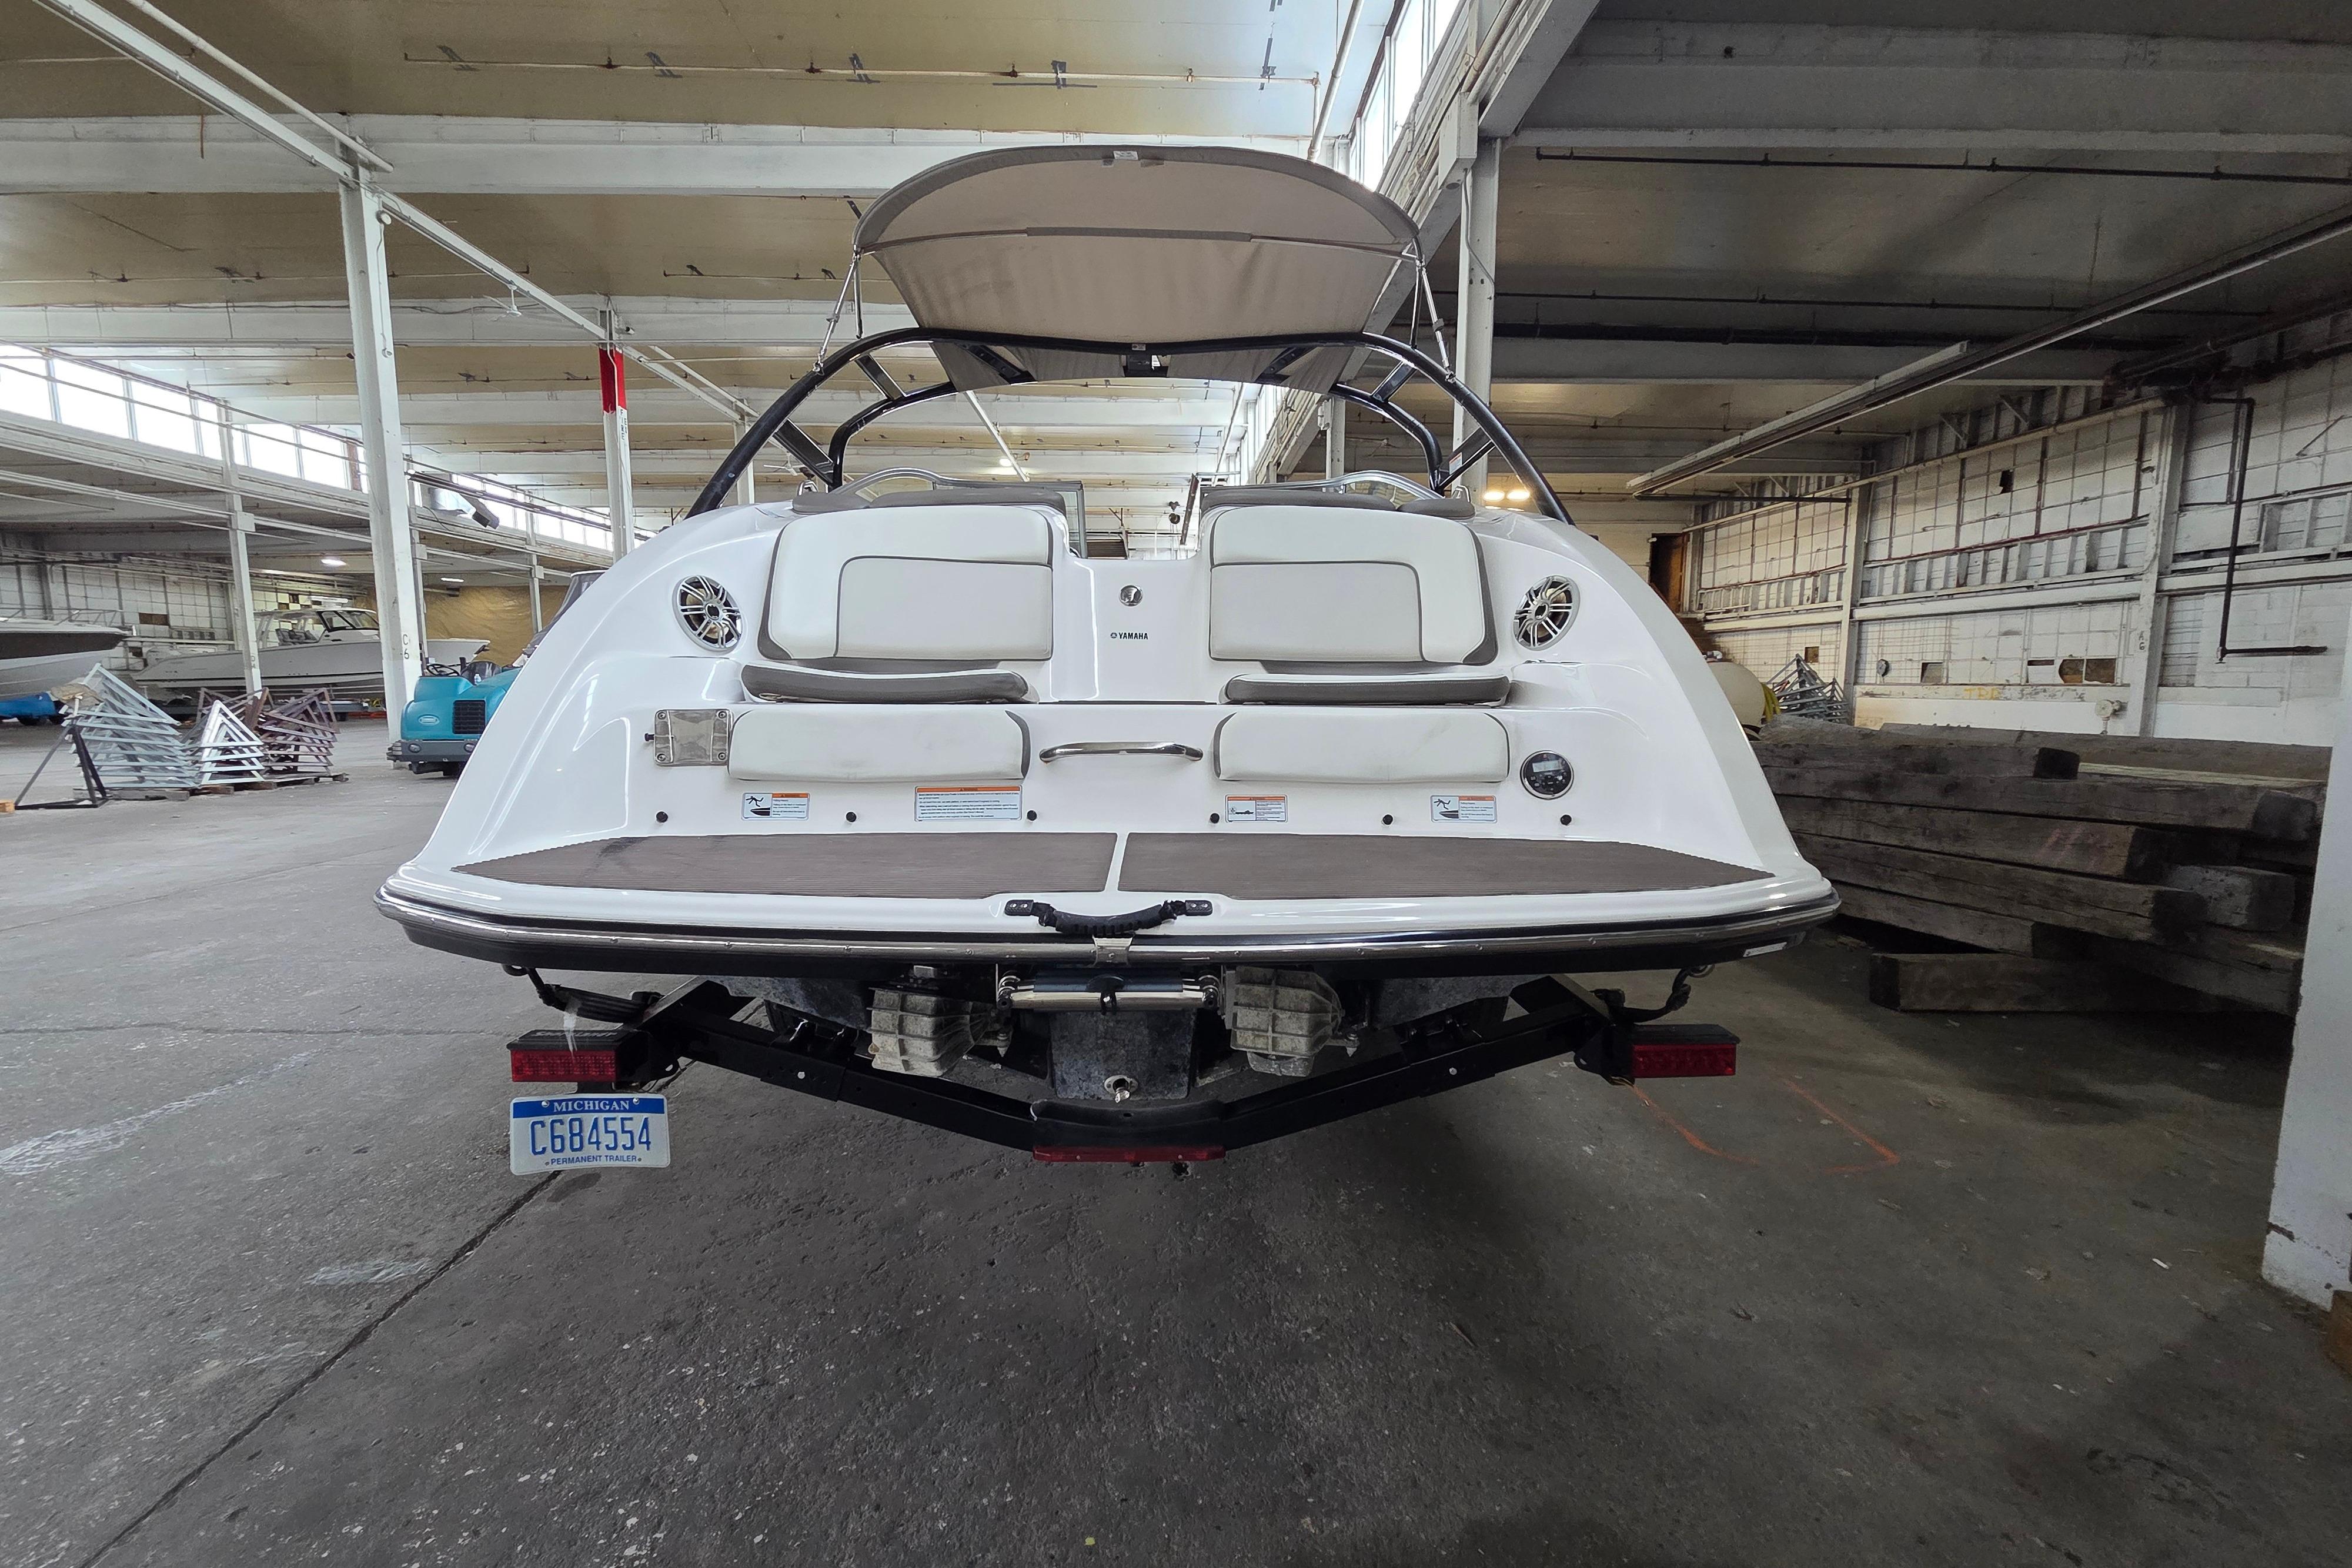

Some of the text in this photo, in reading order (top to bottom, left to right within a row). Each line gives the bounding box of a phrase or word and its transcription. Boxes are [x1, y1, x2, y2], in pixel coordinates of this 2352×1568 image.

[553, 1100, 629, 1112] MICHIGAN
[530, 1116, 652, 1155] C684554
[550, 1155, 602, 1165] PERMANENT
